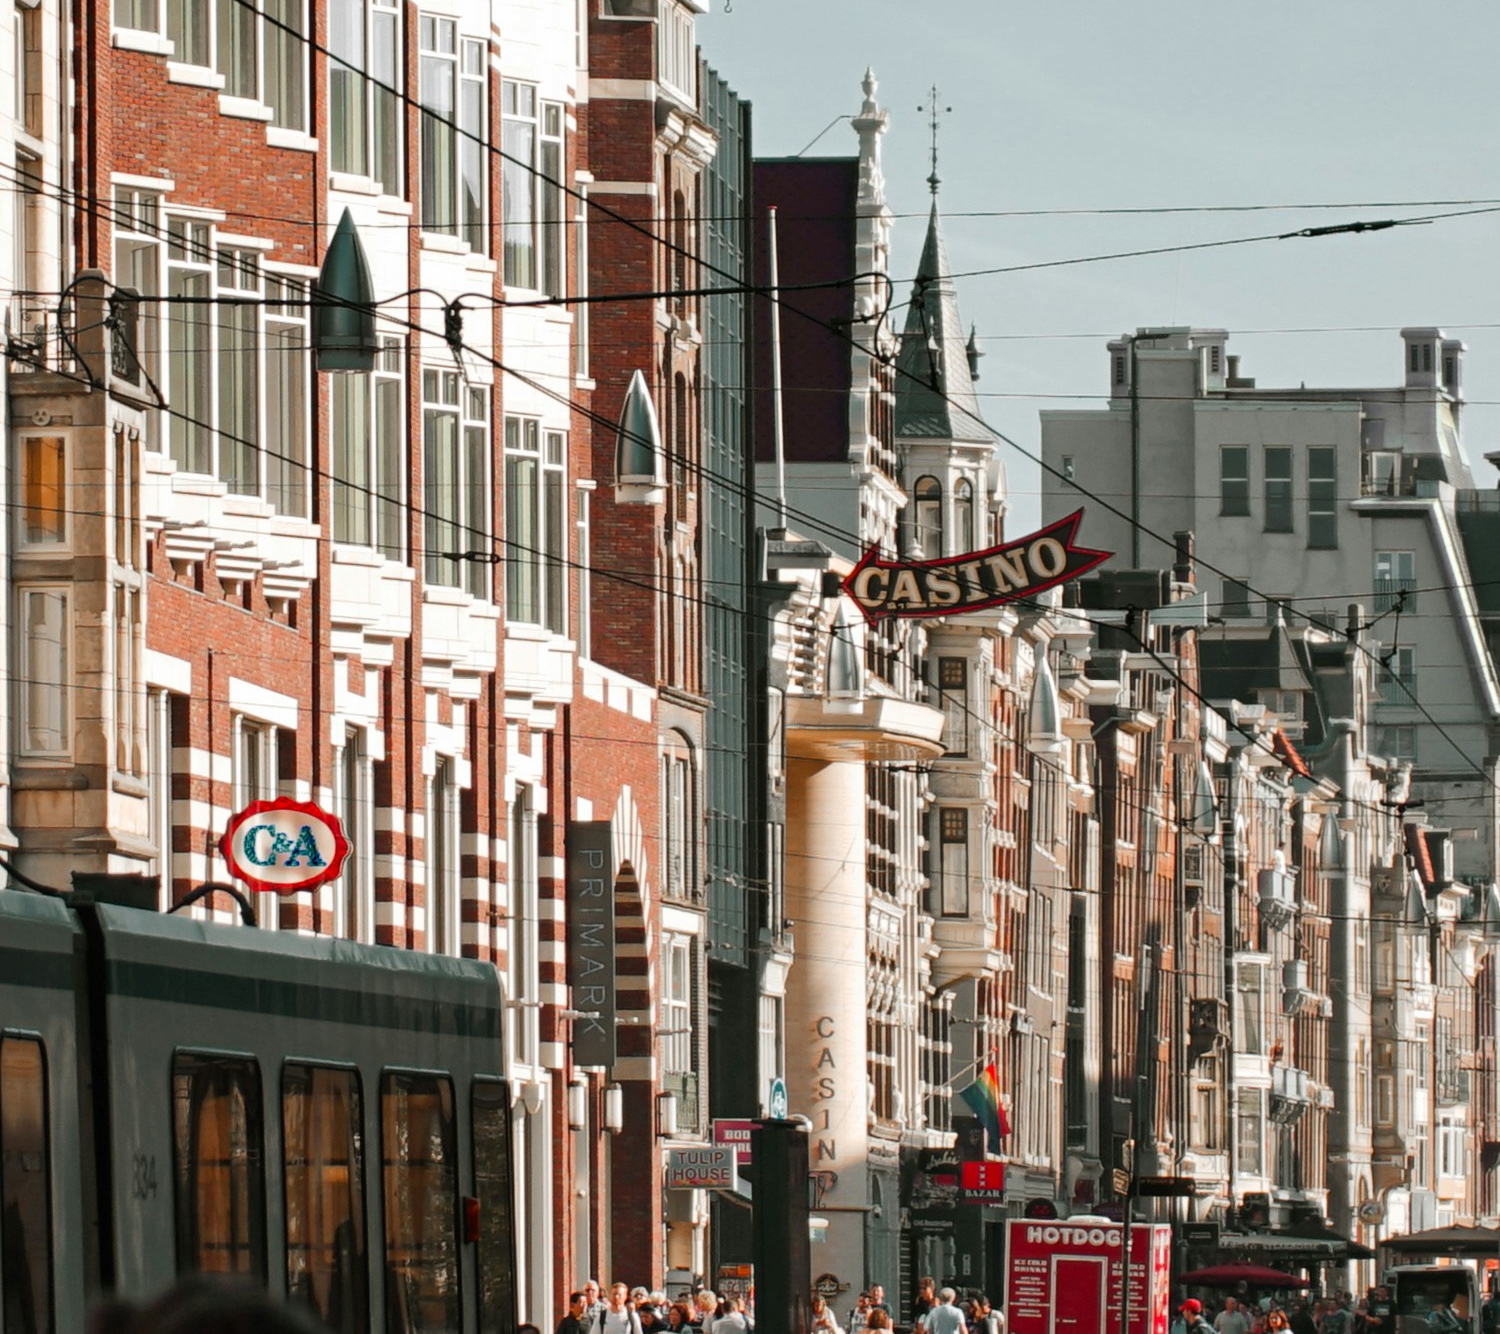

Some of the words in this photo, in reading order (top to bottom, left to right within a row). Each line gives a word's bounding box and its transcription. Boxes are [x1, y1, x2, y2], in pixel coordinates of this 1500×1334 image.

[855, 537, 1067, 609] CASINO
[244, 824, 327, 867] C&A
[578, 848, 605, 1037] PRIMARK
[673, 1165, 730, 1181] HOUSE
[678, 1151, 723, 1166] TULIP
[965, 1189, 1000, 1198] BAZAR
